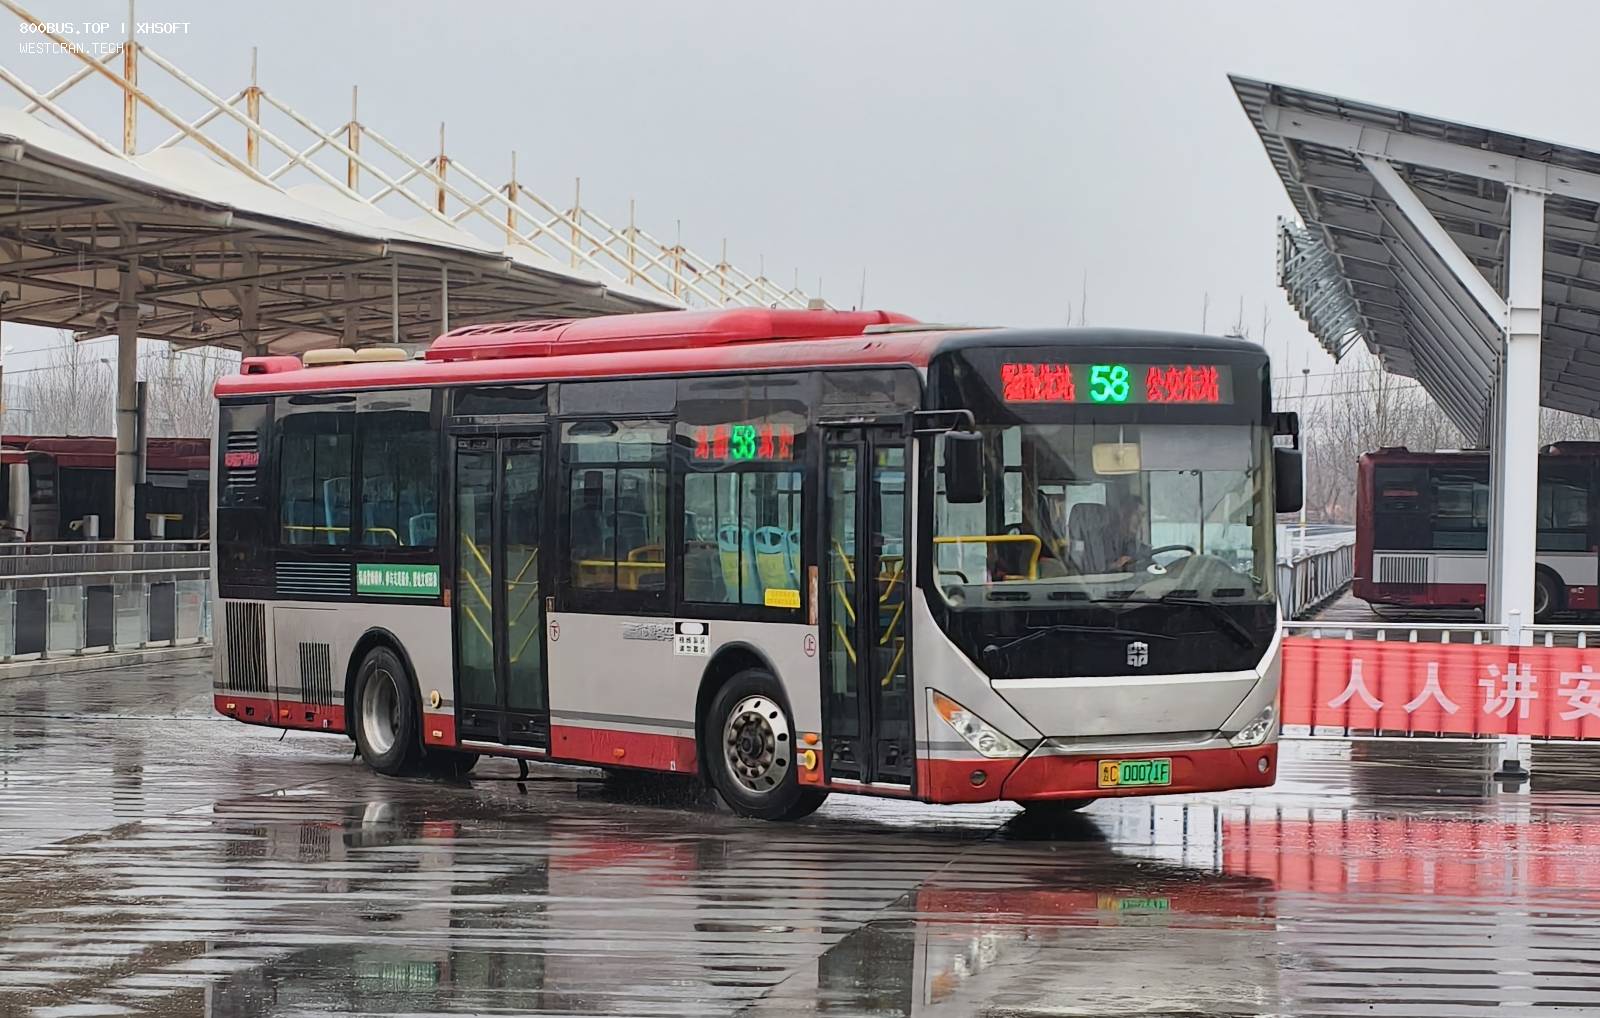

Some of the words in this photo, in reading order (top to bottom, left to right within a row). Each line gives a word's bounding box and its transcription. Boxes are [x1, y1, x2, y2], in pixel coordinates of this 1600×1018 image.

[1090, 364, 1129, 402] 58
[732, 425, 756, 459] 58
[1328, 658, 1600, 721] 人人讲安
